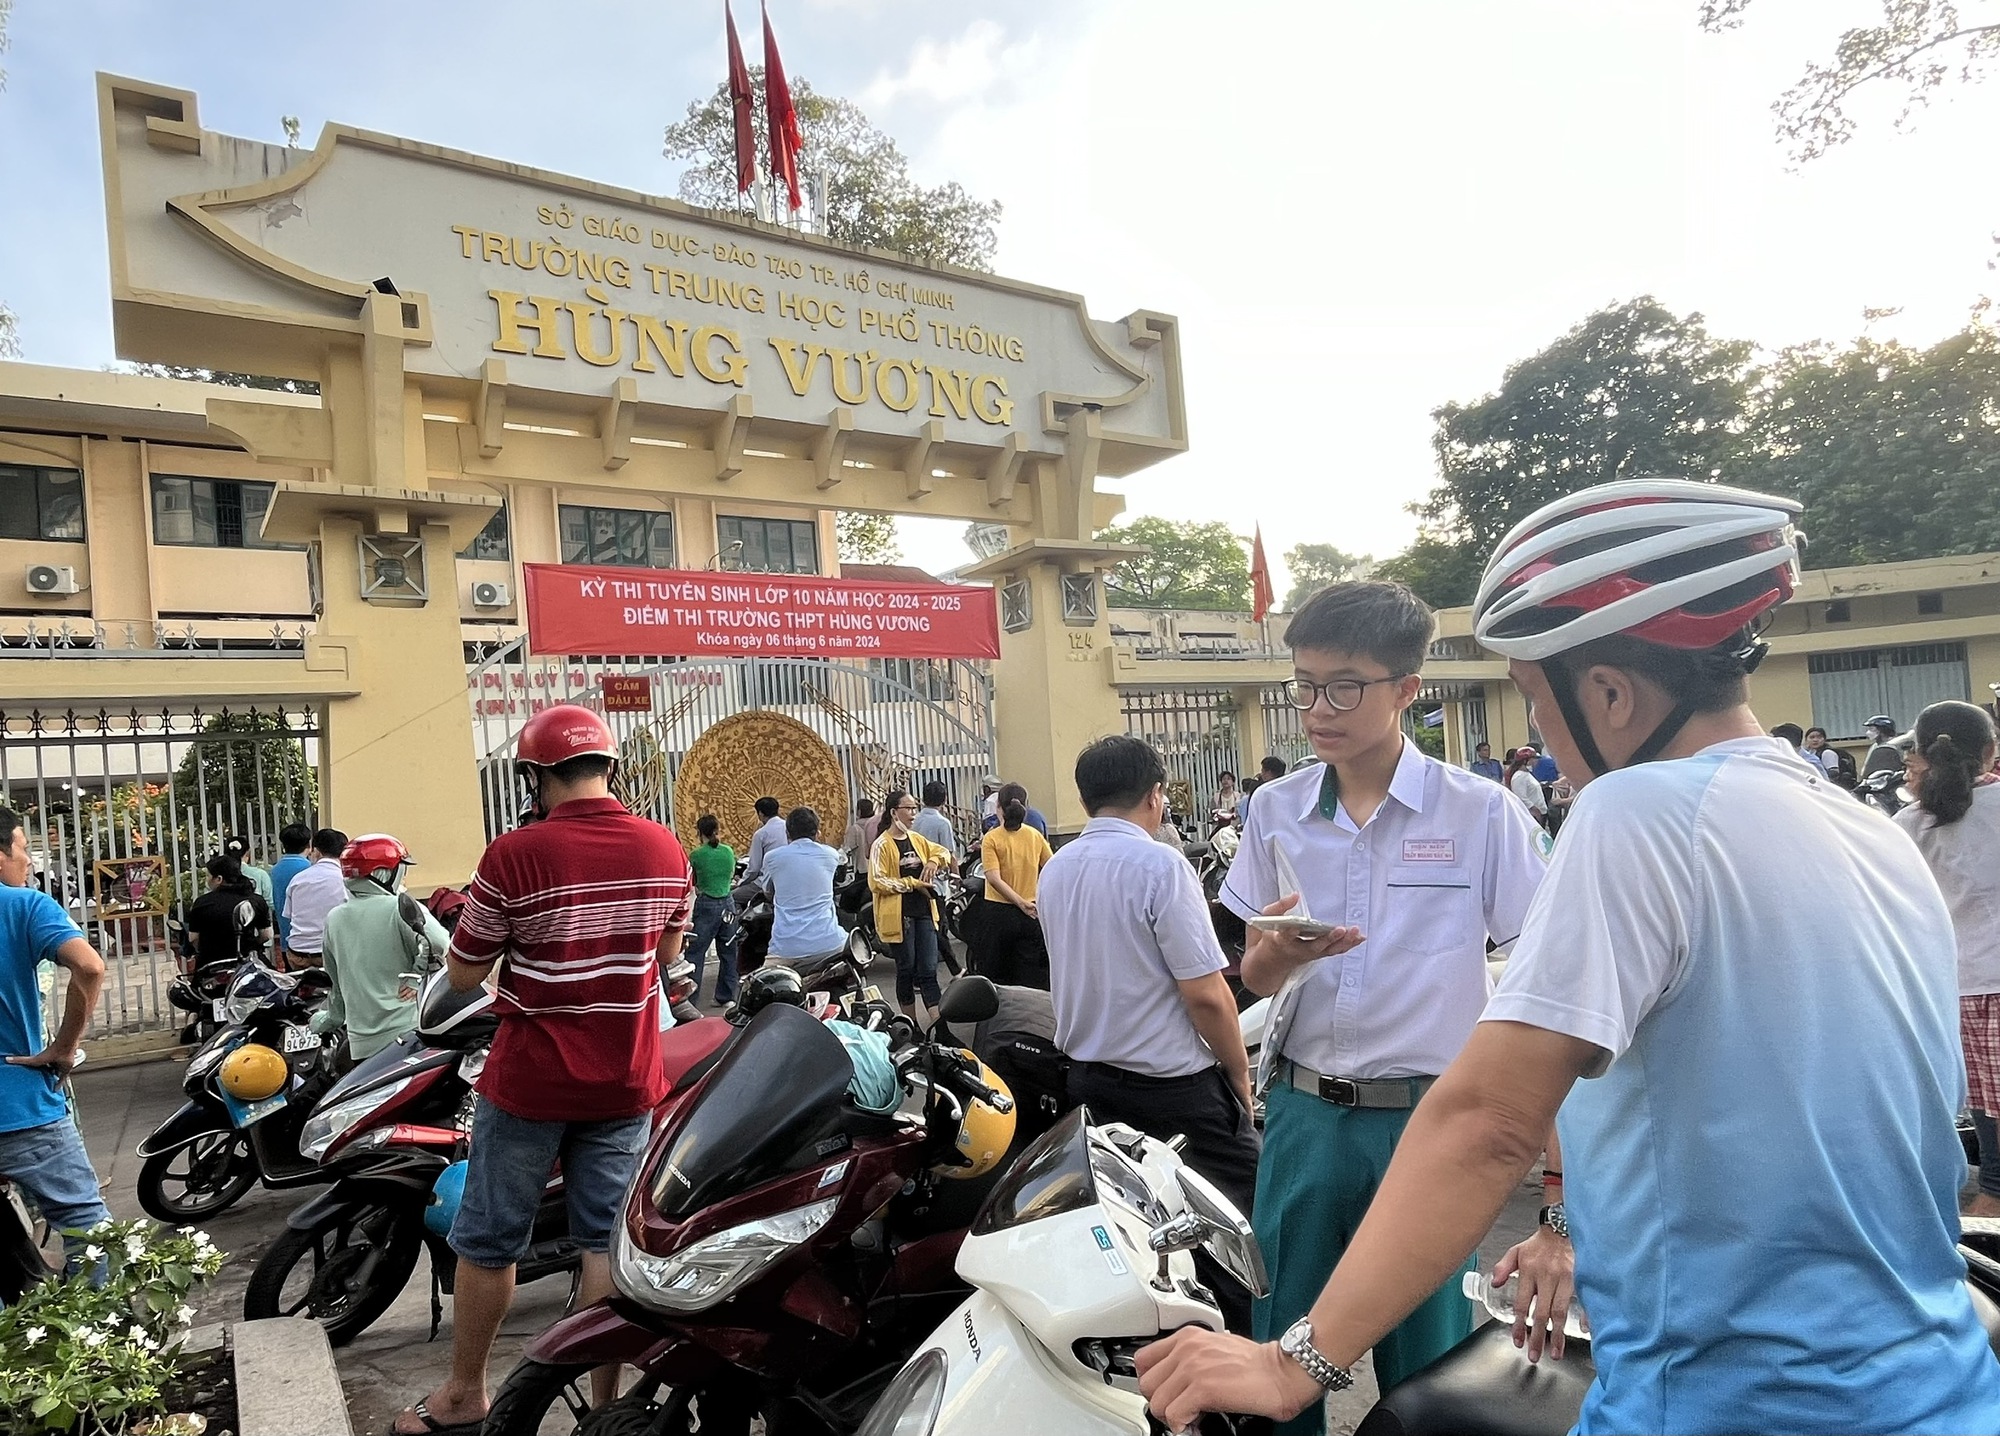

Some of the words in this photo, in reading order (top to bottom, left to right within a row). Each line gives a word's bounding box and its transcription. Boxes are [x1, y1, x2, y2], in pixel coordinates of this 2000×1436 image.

[537, 203, 575, 229] SỞ
[583, 216, 642, 244] GIÁO
[765, 255, 804, 279] TẠO
[810, 264, 838, 287] TP.
[912, 287, 955, 310] MINH
[451, 224, 632, 288] TRƯỜNG
[643, 263, 765, 313] TRUNG
[778, 291, 847, 331] HỌC
[859, 306, 921, 342] PHỔ
[928, 320, 1025, 362] THÔNG
[487, 285, 748, 387] HÙNG
[768, 337, 1015, 426] VƯƠNG
[611, 581, 642, 599] THI
[646, 580, 706, 602] TUYỂN
[710, 585, 751, 603] SINH
[754, 584, 789, 605] LỚP
[793, 589, 810, 606] 10
[814, 587, 849, 607] NĂM
[853, 592, 884, 611] HỌC
[888, 594, 920, 609] 2024
[931, 596, 961, 611] 2025
[623, 604, 669, 626] ĐIỂM
[673, 608, 702, 626] THI
[706, 607, 781, 629] TRƯỜNG
[784, 612, 826, 629] THPT
[829, 610, 873, 631] HÙNG
[876, 615, 931, 632] VƯƠNG
[696, 632, 730, 646] Khóa
[733, 633, 763, 649] ngày
[765, 633, 780, 647] 06
[782, 633, 817, 649] tháng
[818, 635, 826, 647] 6
[828, 636, 853, 648] năm
[855, 635, 881, 648] 2024
[1068, 632, 1093, 649] 124
[614, 680, 640, 691] CẤM
[634, 696, 650, 705] XE
[668, 1163, 691, 1189] HONDA
[964, 1309, 981, 1364] HONDA
